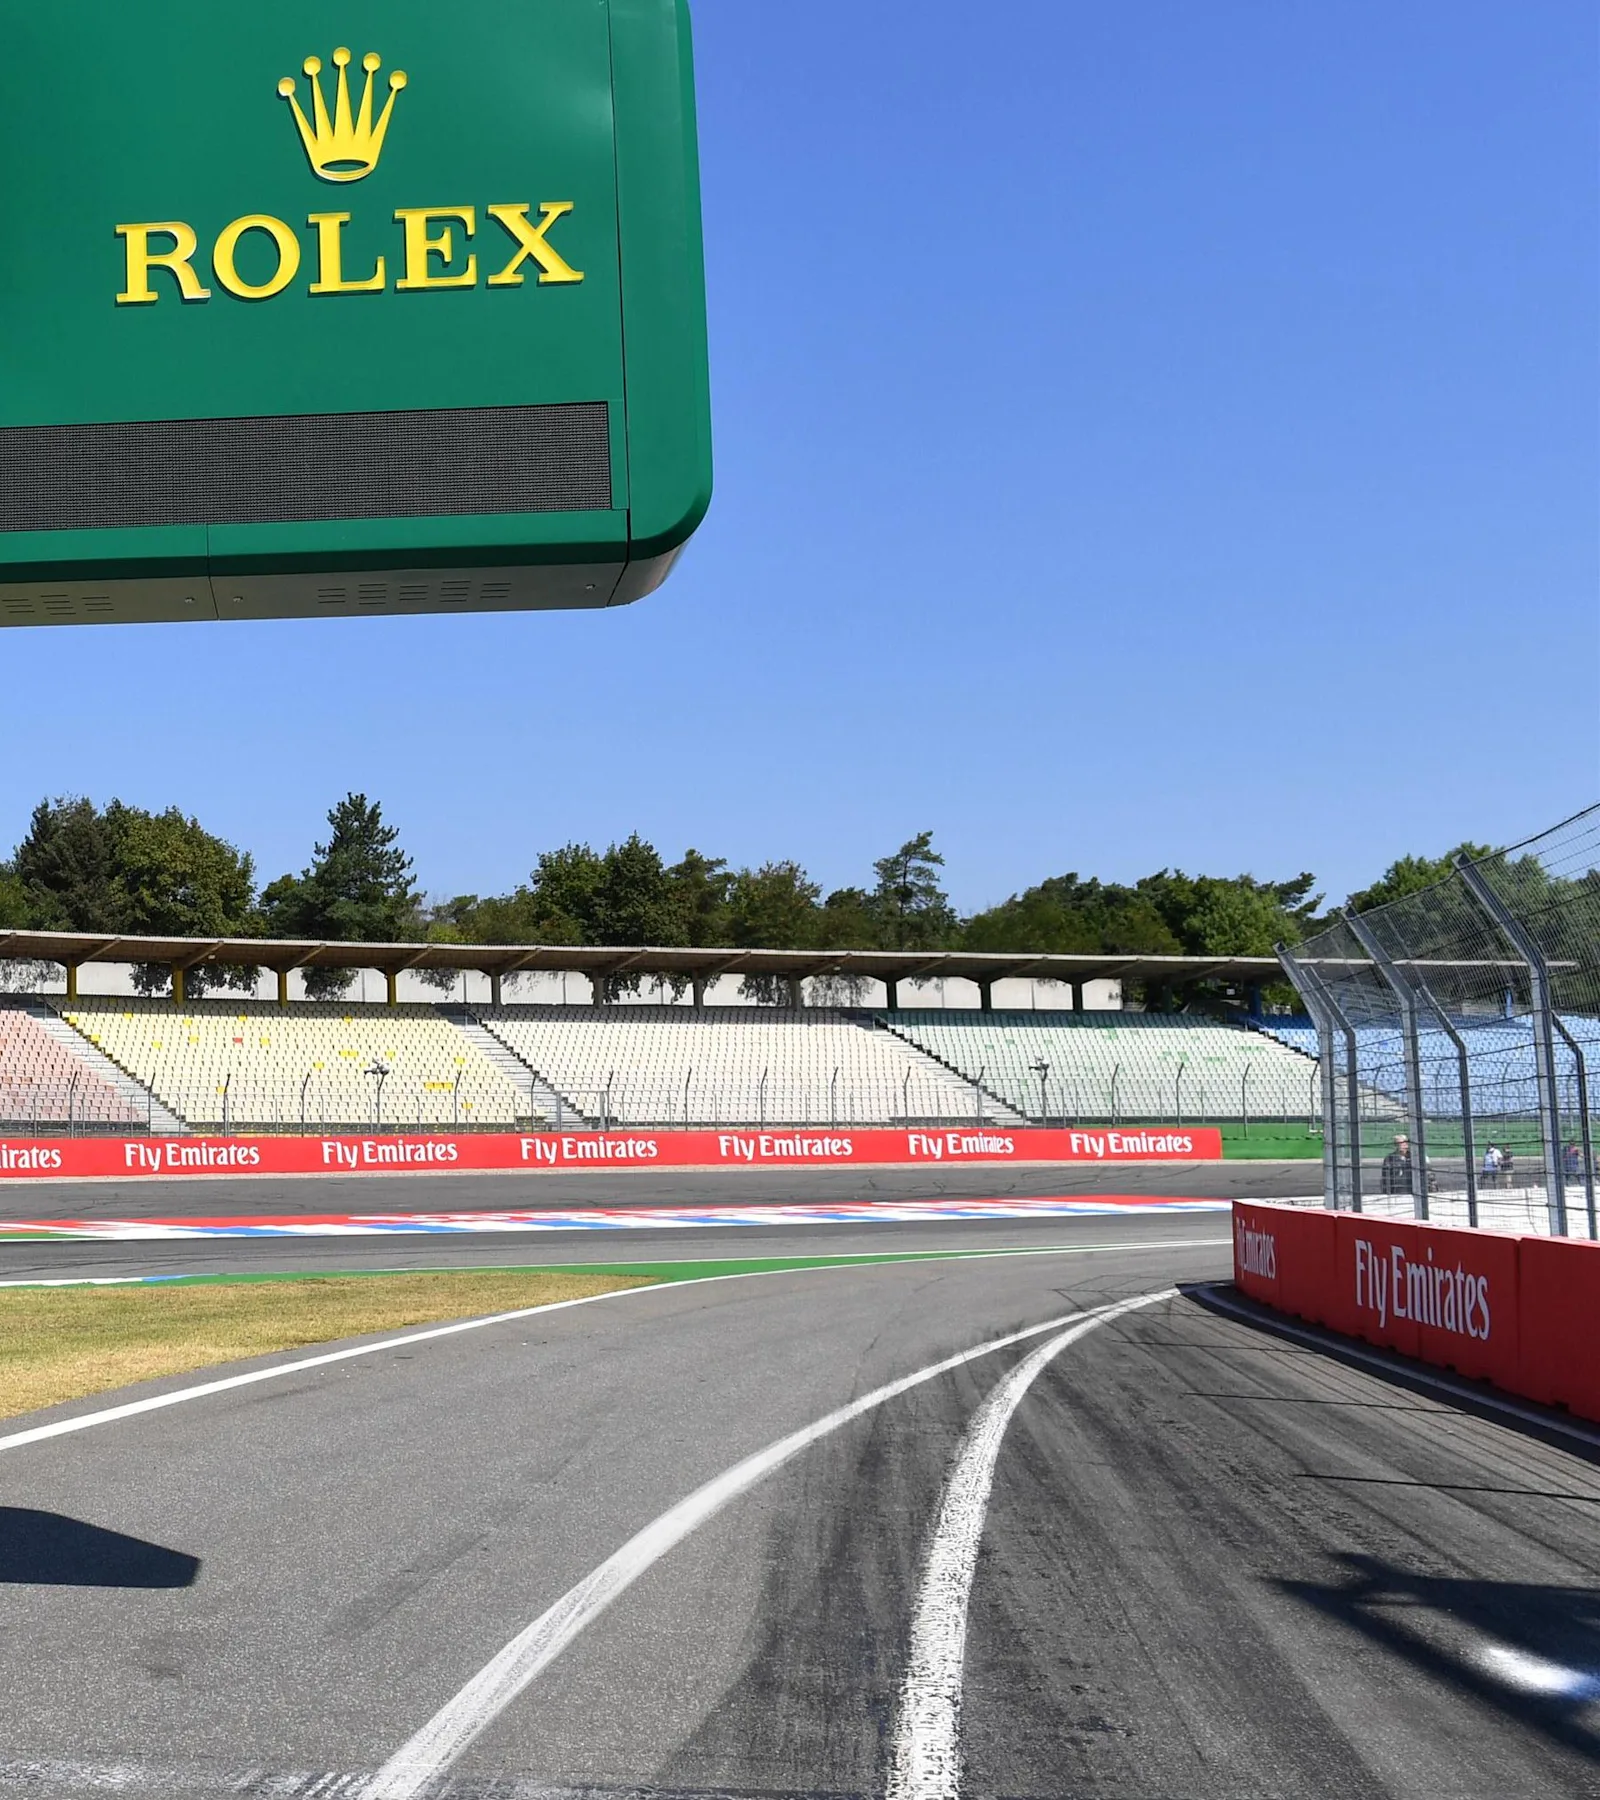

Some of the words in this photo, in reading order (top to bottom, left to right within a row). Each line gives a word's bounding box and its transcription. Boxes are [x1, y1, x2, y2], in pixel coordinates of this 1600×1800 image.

[114, 200, 585, 306] ROLEX
[124, 1143, 162, 1172] Fly
[164, 1141, 261, 1167] Emirates
[321, 1141, 359, 1169] Fly
[361, 1138, 458, 1164] Emirates
[519, 1137, 558, 1165] Fly
[561, 1135, 658, 1160] Emirates
[717, 1135, 755, 1162] Fly
[758, 1133, 853, 1157] Emirates
[907, 1133, 943, 1160] Fly
[945, 1131, 1015, 1155] Emirates
[1069, 1132, 1105, 1158] Fly
[1106, 1131, 1193, 1154] Emirates
[1354, 1239, 1387, 1328] Fly
[1391, 1244, 1490, 1340] Emirates
